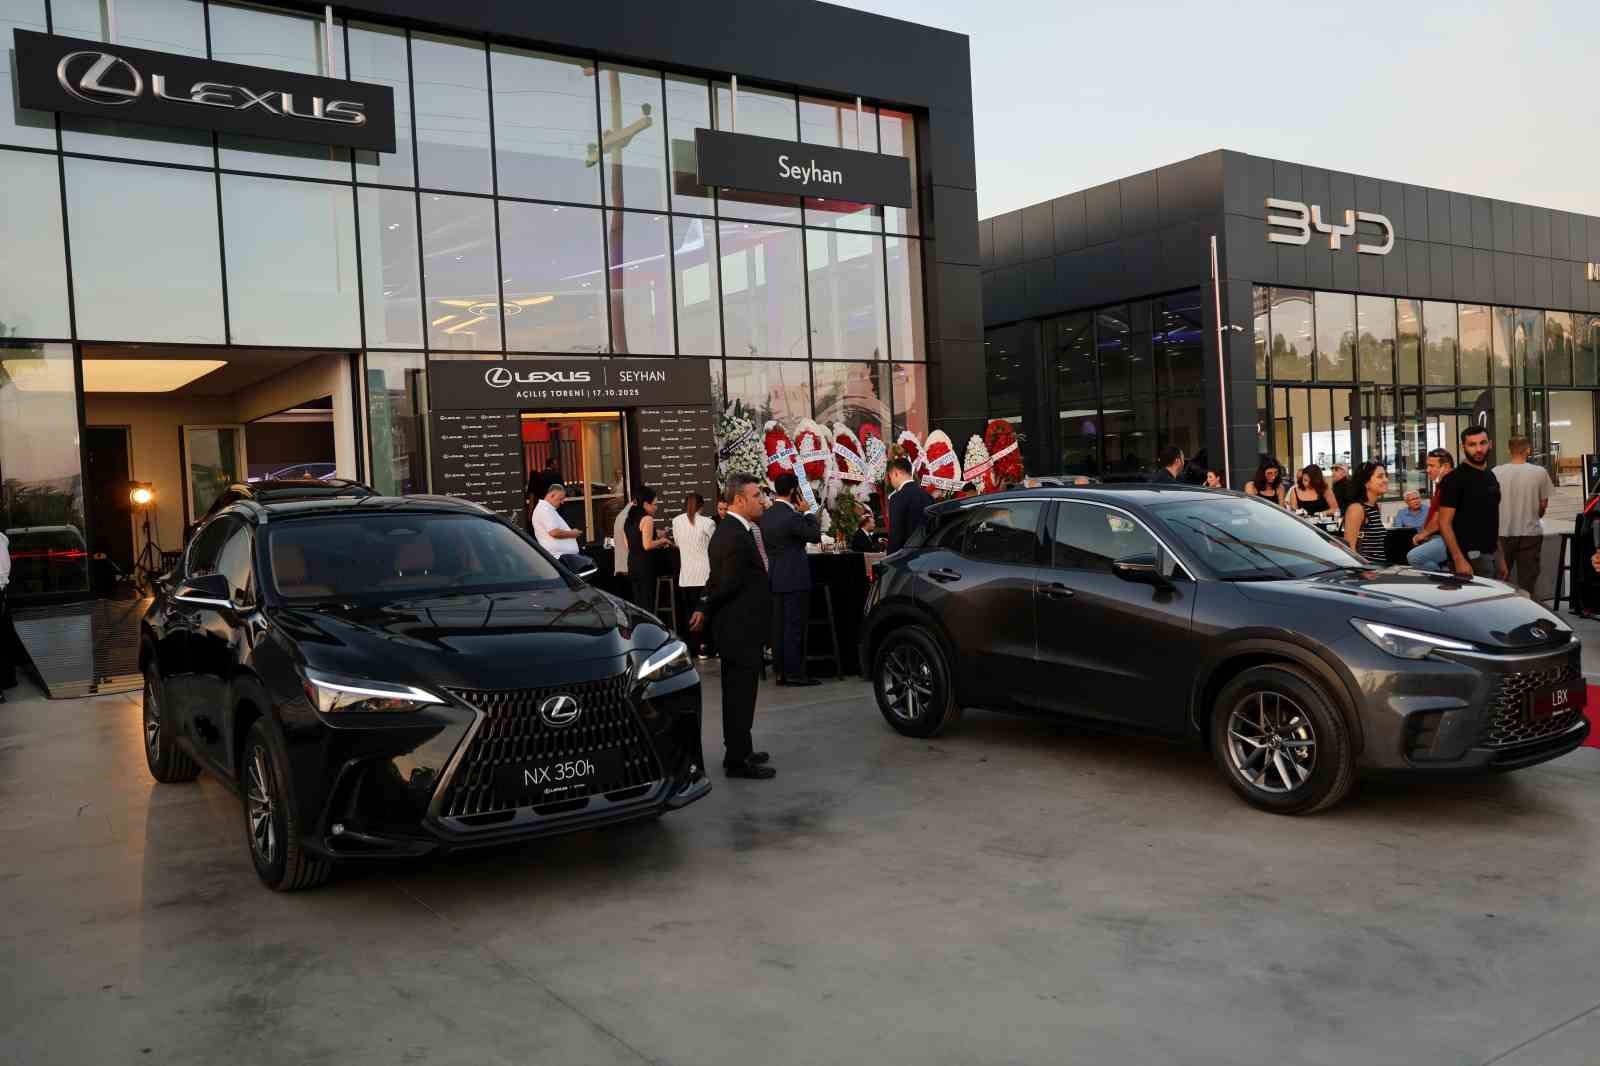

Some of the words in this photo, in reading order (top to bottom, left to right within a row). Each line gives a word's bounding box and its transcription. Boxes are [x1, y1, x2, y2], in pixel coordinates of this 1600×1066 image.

[151, 73, 367, 126] LEXUS
[778, 154, 843, 185] Seyhan
[1264, 197, 1395, 256] BYD
[514, 370, 592, 383] LEXUS
[618, 370, 667, 383] SEYHAN
[592, 388, 640, 398] 17.10.2025
[1552, 689, 1568, 706] LBX
[524, 765, 552, 786] NX
[554, 759, 595, 781] 350h
